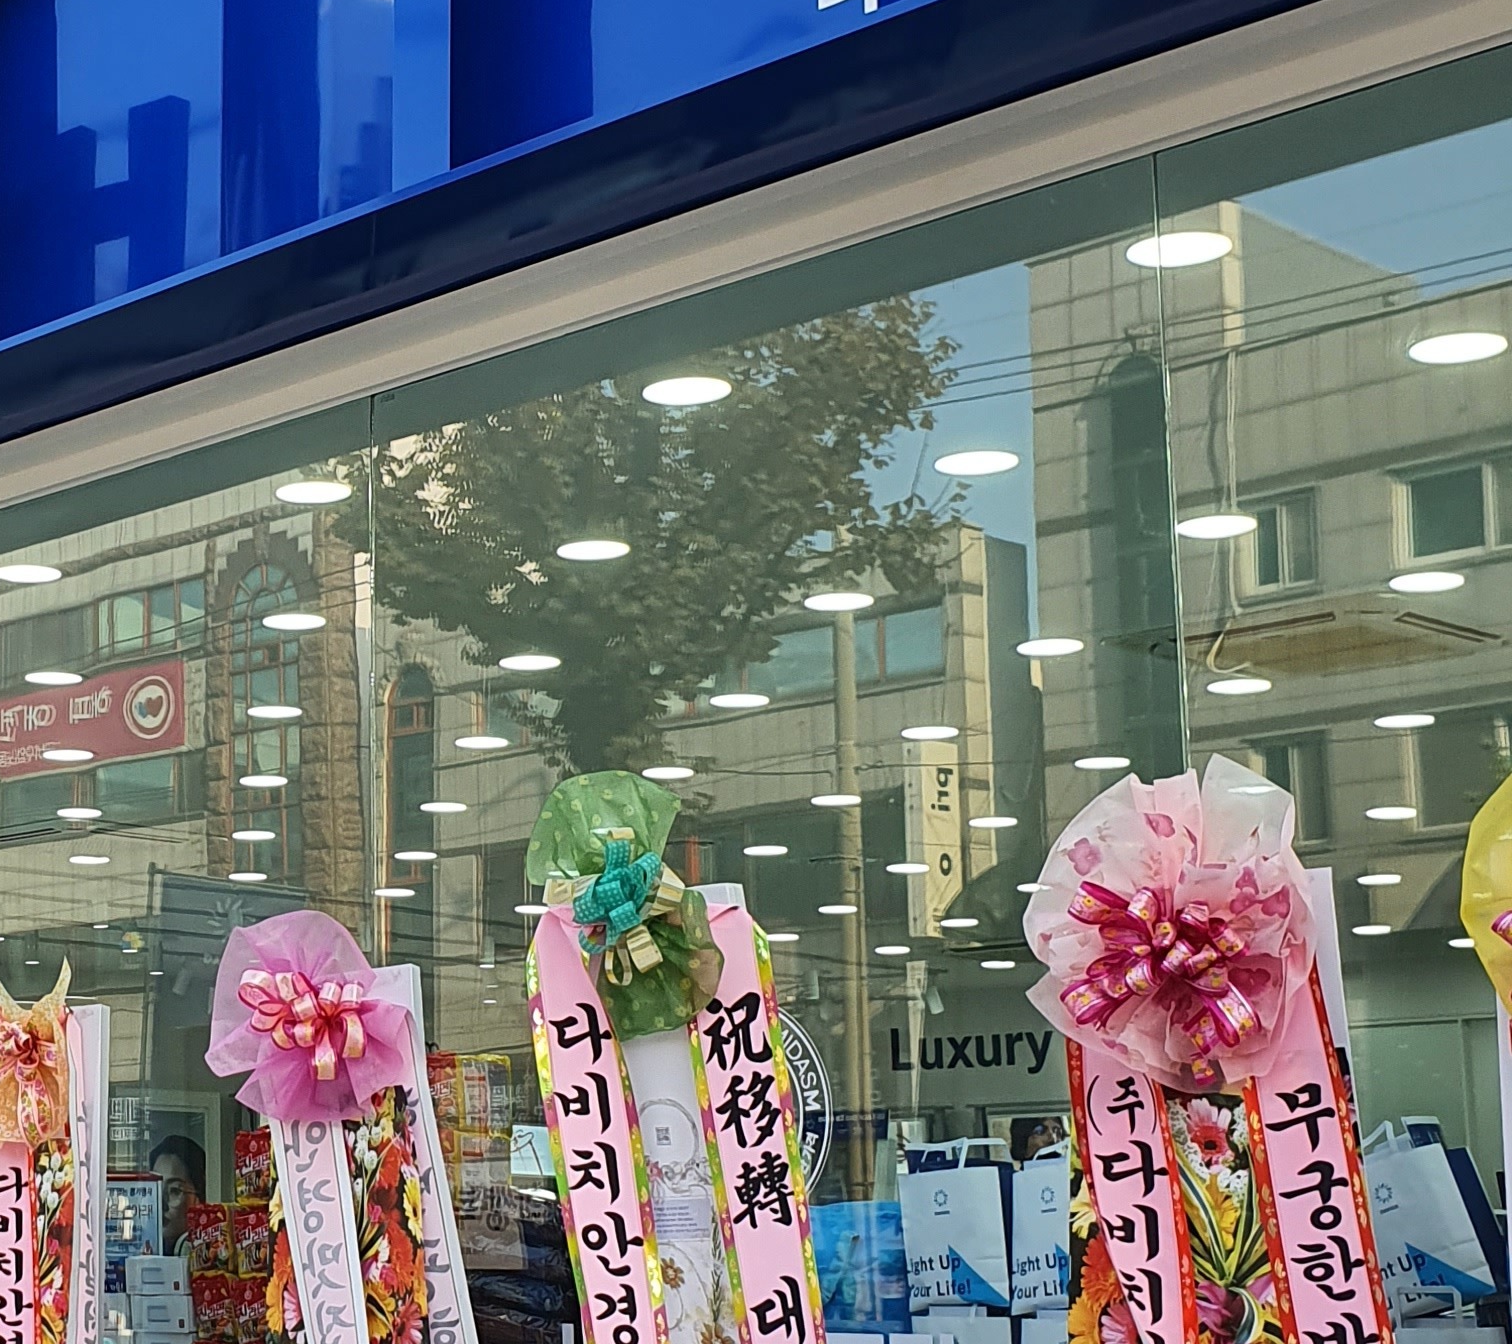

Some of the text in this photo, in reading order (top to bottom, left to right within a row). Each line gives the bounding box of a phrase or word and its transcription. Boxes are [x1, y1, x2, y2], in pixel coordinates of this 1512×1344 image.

[890, 1023, 1055, 1072] Luxury
[702, 991, 795, 1230] 祝移轉
[939, 1254, 962, 1273] Up
[936, 1278, 972, 1298] Life!
